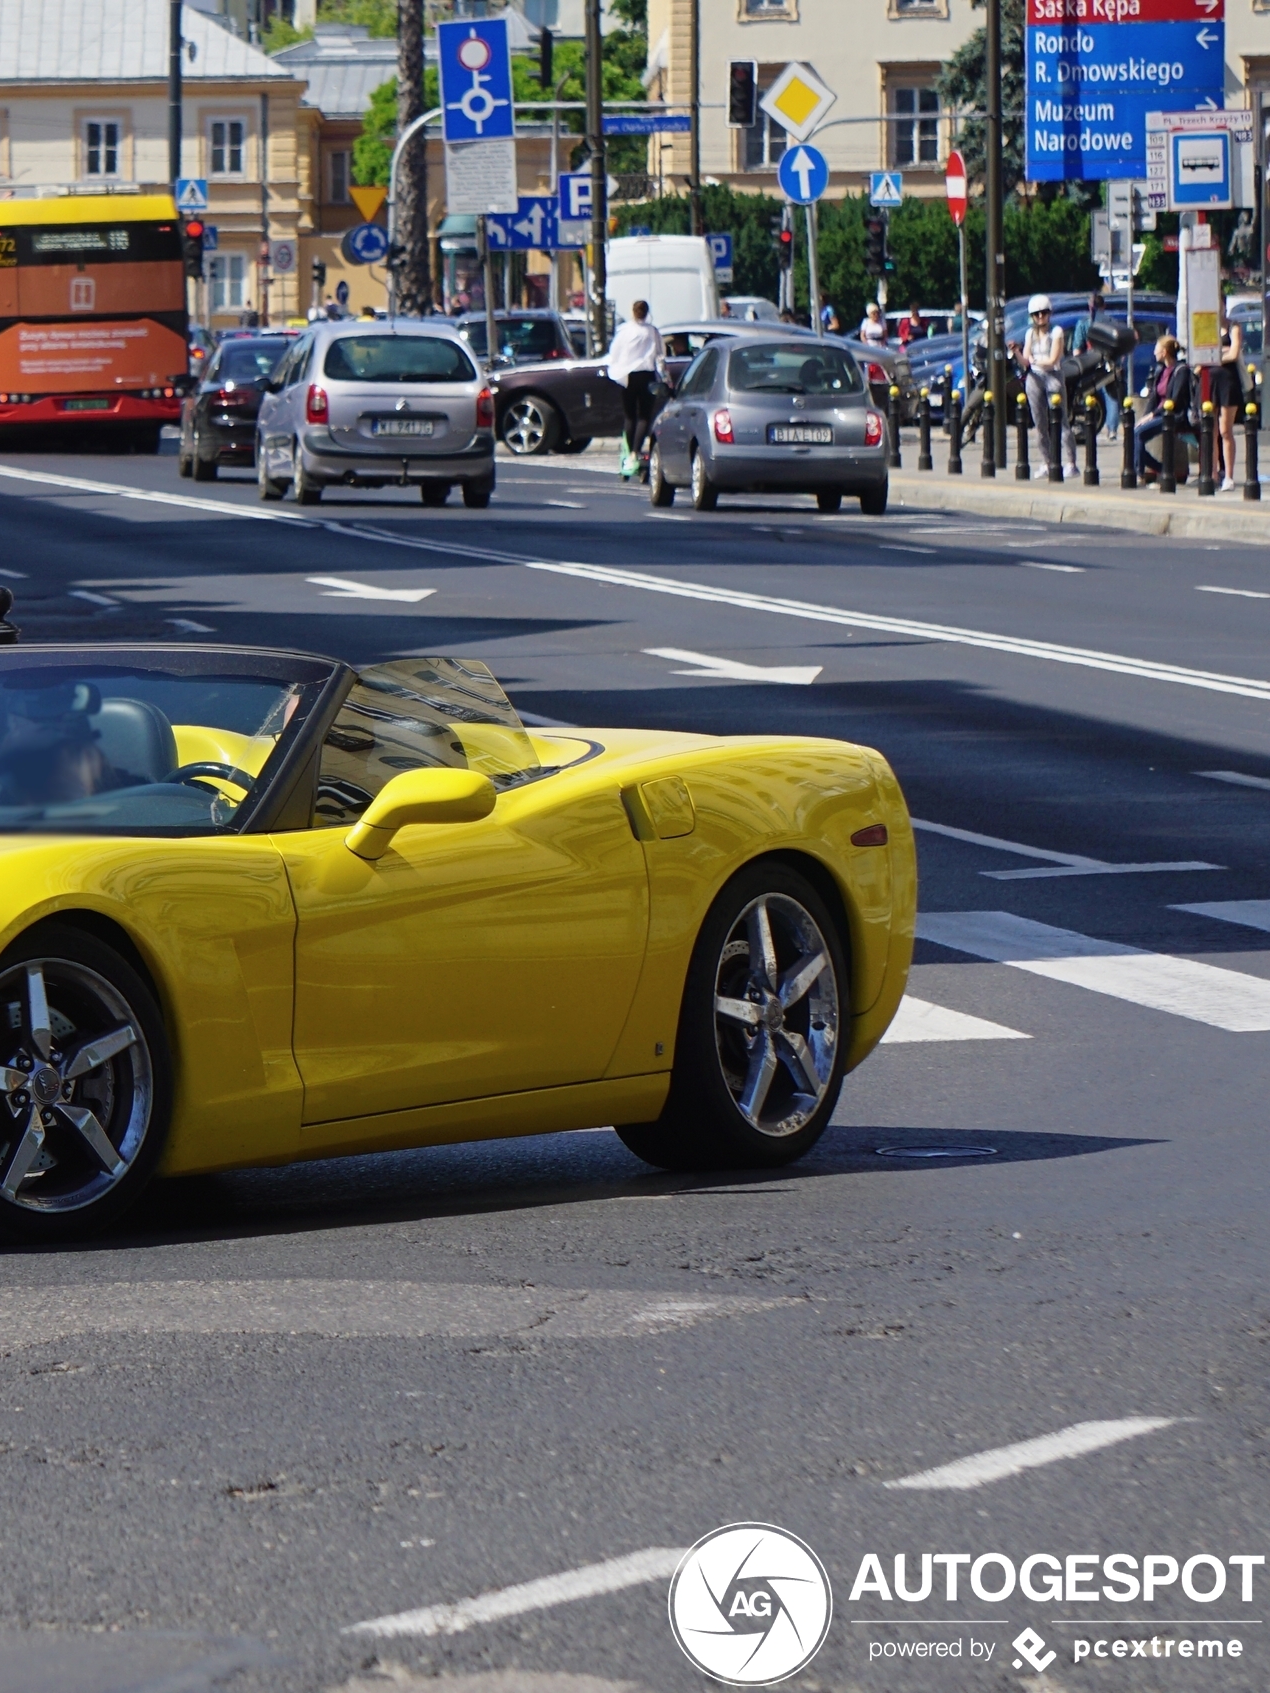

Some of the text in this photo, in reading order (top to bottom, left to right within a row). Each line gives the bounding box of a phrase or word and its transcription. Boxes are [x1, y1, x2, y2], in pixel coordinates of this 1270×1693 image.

[1035, 0, 1140, 21] Saska Kępa
[1035, 30, 1094, 53] Rondo
[1035, 57, 1184, 86] R. Dmowskiego
[1035, 100, 1114, 122] Muzeum
[1035, 130, 1133, 152] Narodowe
[1150, 152, 1163, 160] 116
[1150, 167, 1164, 175] 127
[1150, 183, 1164, 191] 171
[1149, 196, 1166, 208] N33
